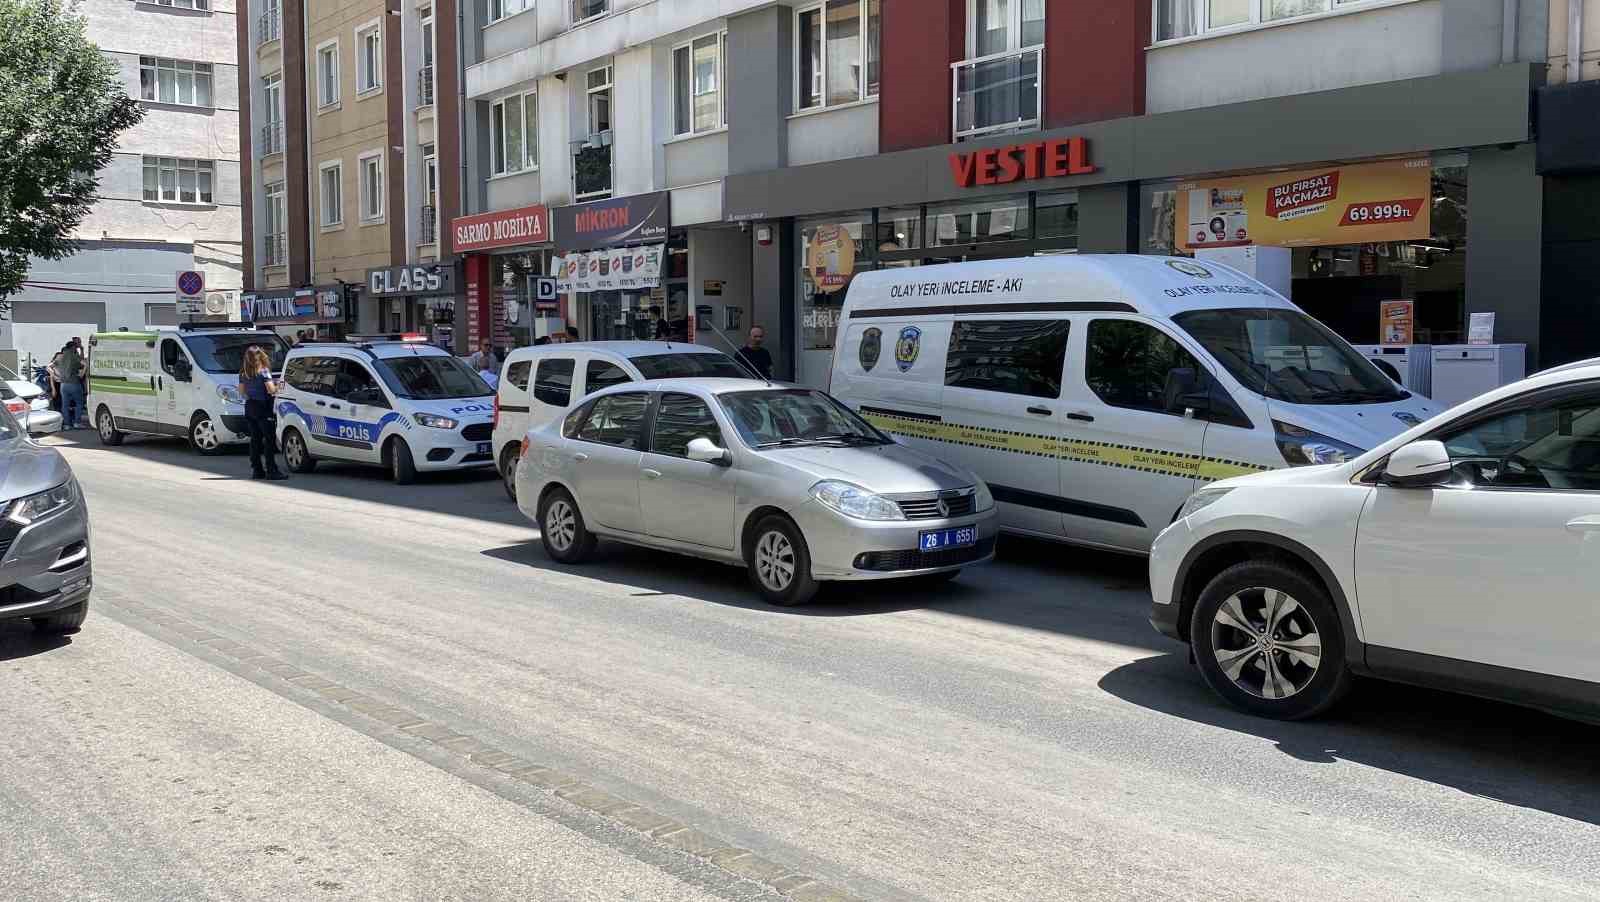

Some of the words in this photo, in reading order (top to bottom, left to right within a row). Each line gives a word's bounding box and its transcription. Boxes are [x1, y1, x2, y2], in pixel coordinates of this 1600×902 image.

[948, 137, 1095, 188] VESTEL
[1274, 185, 1290, 198] BU
[1292, 175, 1331, 193] FIRSAT
[1275, 186, 1332, 209] KAÇMAZ!
[457, 222, 491, 244] SARMO
[493, 213, 541, 240] MOBİLYA
[576, 206, 630, 232] MİKRON
[371, 267, 441, 294] CLASS
[541, 281, 553, 296] D
[891, 283, 916, 298] OLAY
[339, 424, 370, 441] POLİS
[1133, 455, 1150, 464] OLAY
[926, 533, 937, 547] 26
[944, 532, 949, 545] A
[956, 528, 974, 544] 6551
